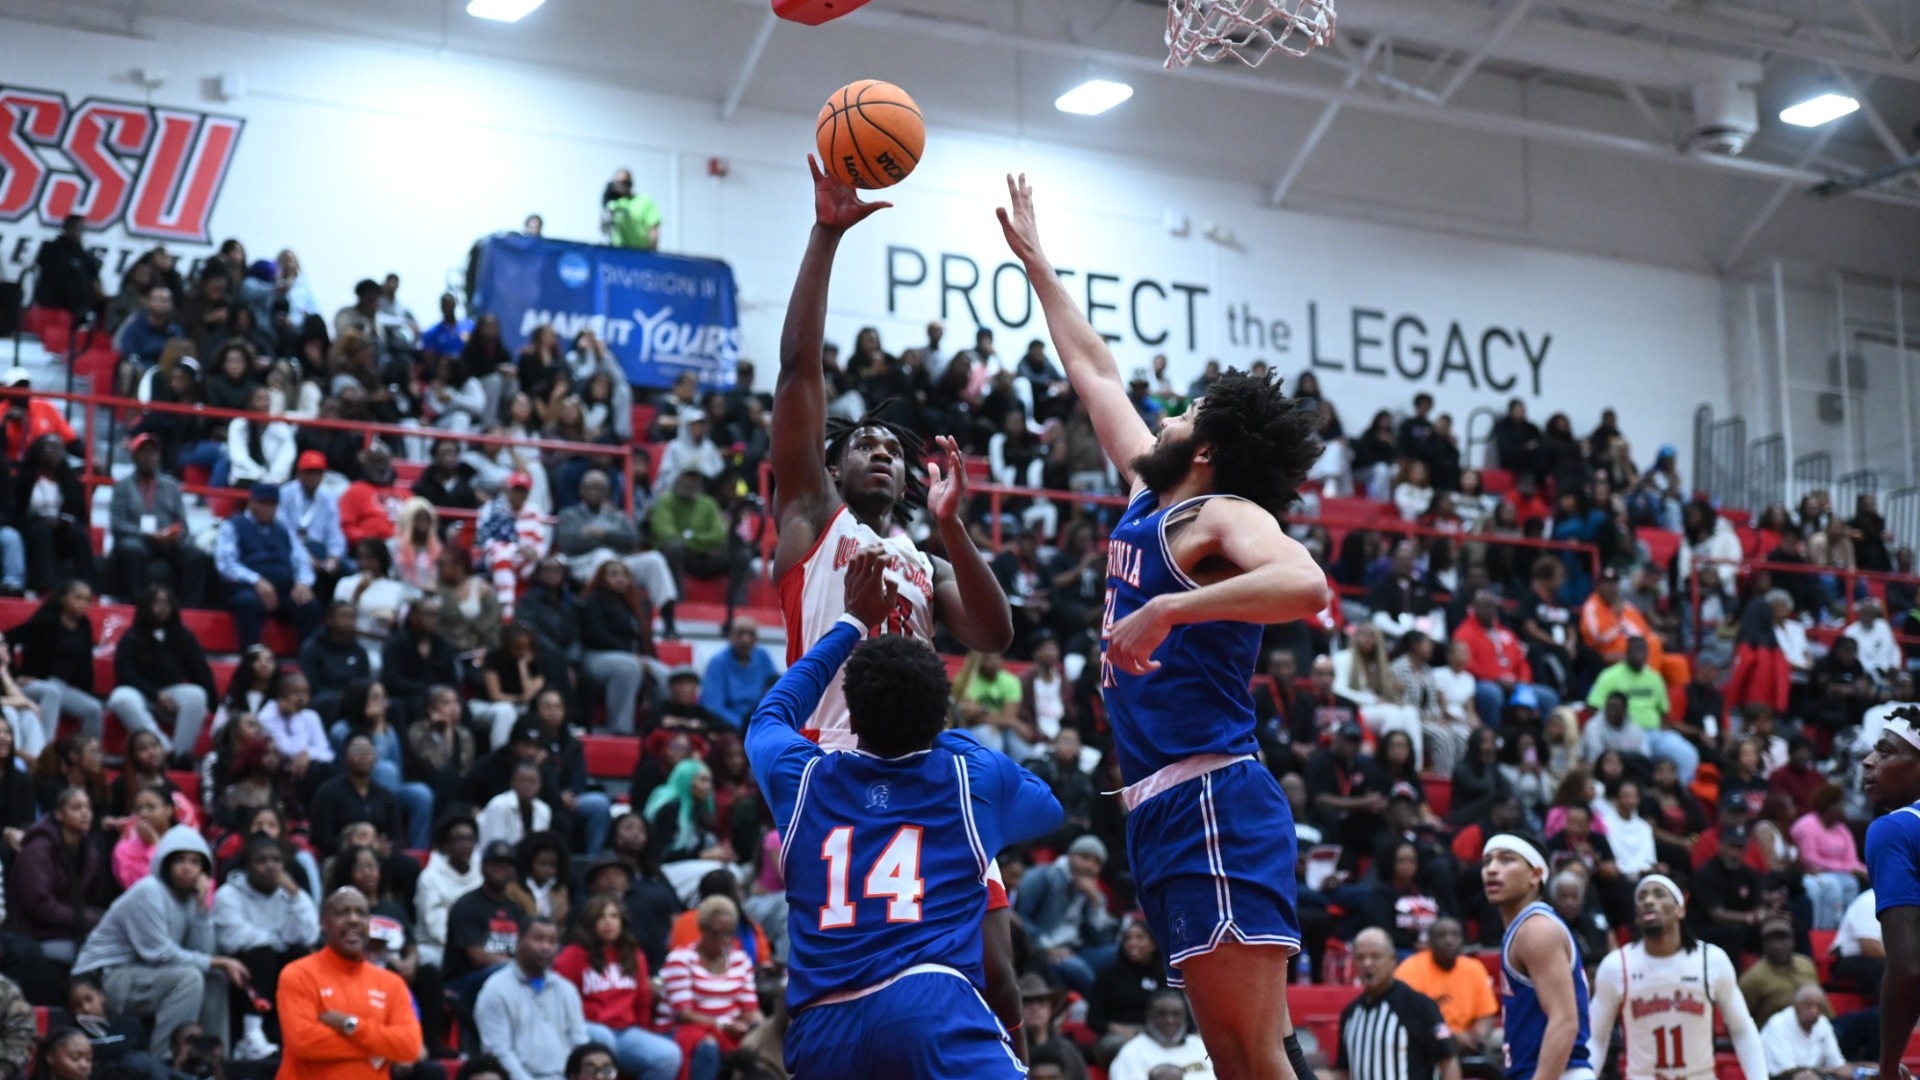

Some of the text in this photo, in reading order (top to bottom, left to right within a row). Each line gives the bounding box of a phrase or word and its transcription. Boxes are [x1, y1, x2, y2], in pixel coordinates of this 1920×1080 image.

[601, 263, 698, 299] DIVISION
[886, 245, 1552, 397] PROECT the LEGACY
[819, 824, 925, 931] 14
[1653, 1024, 1687, 1069] 11
